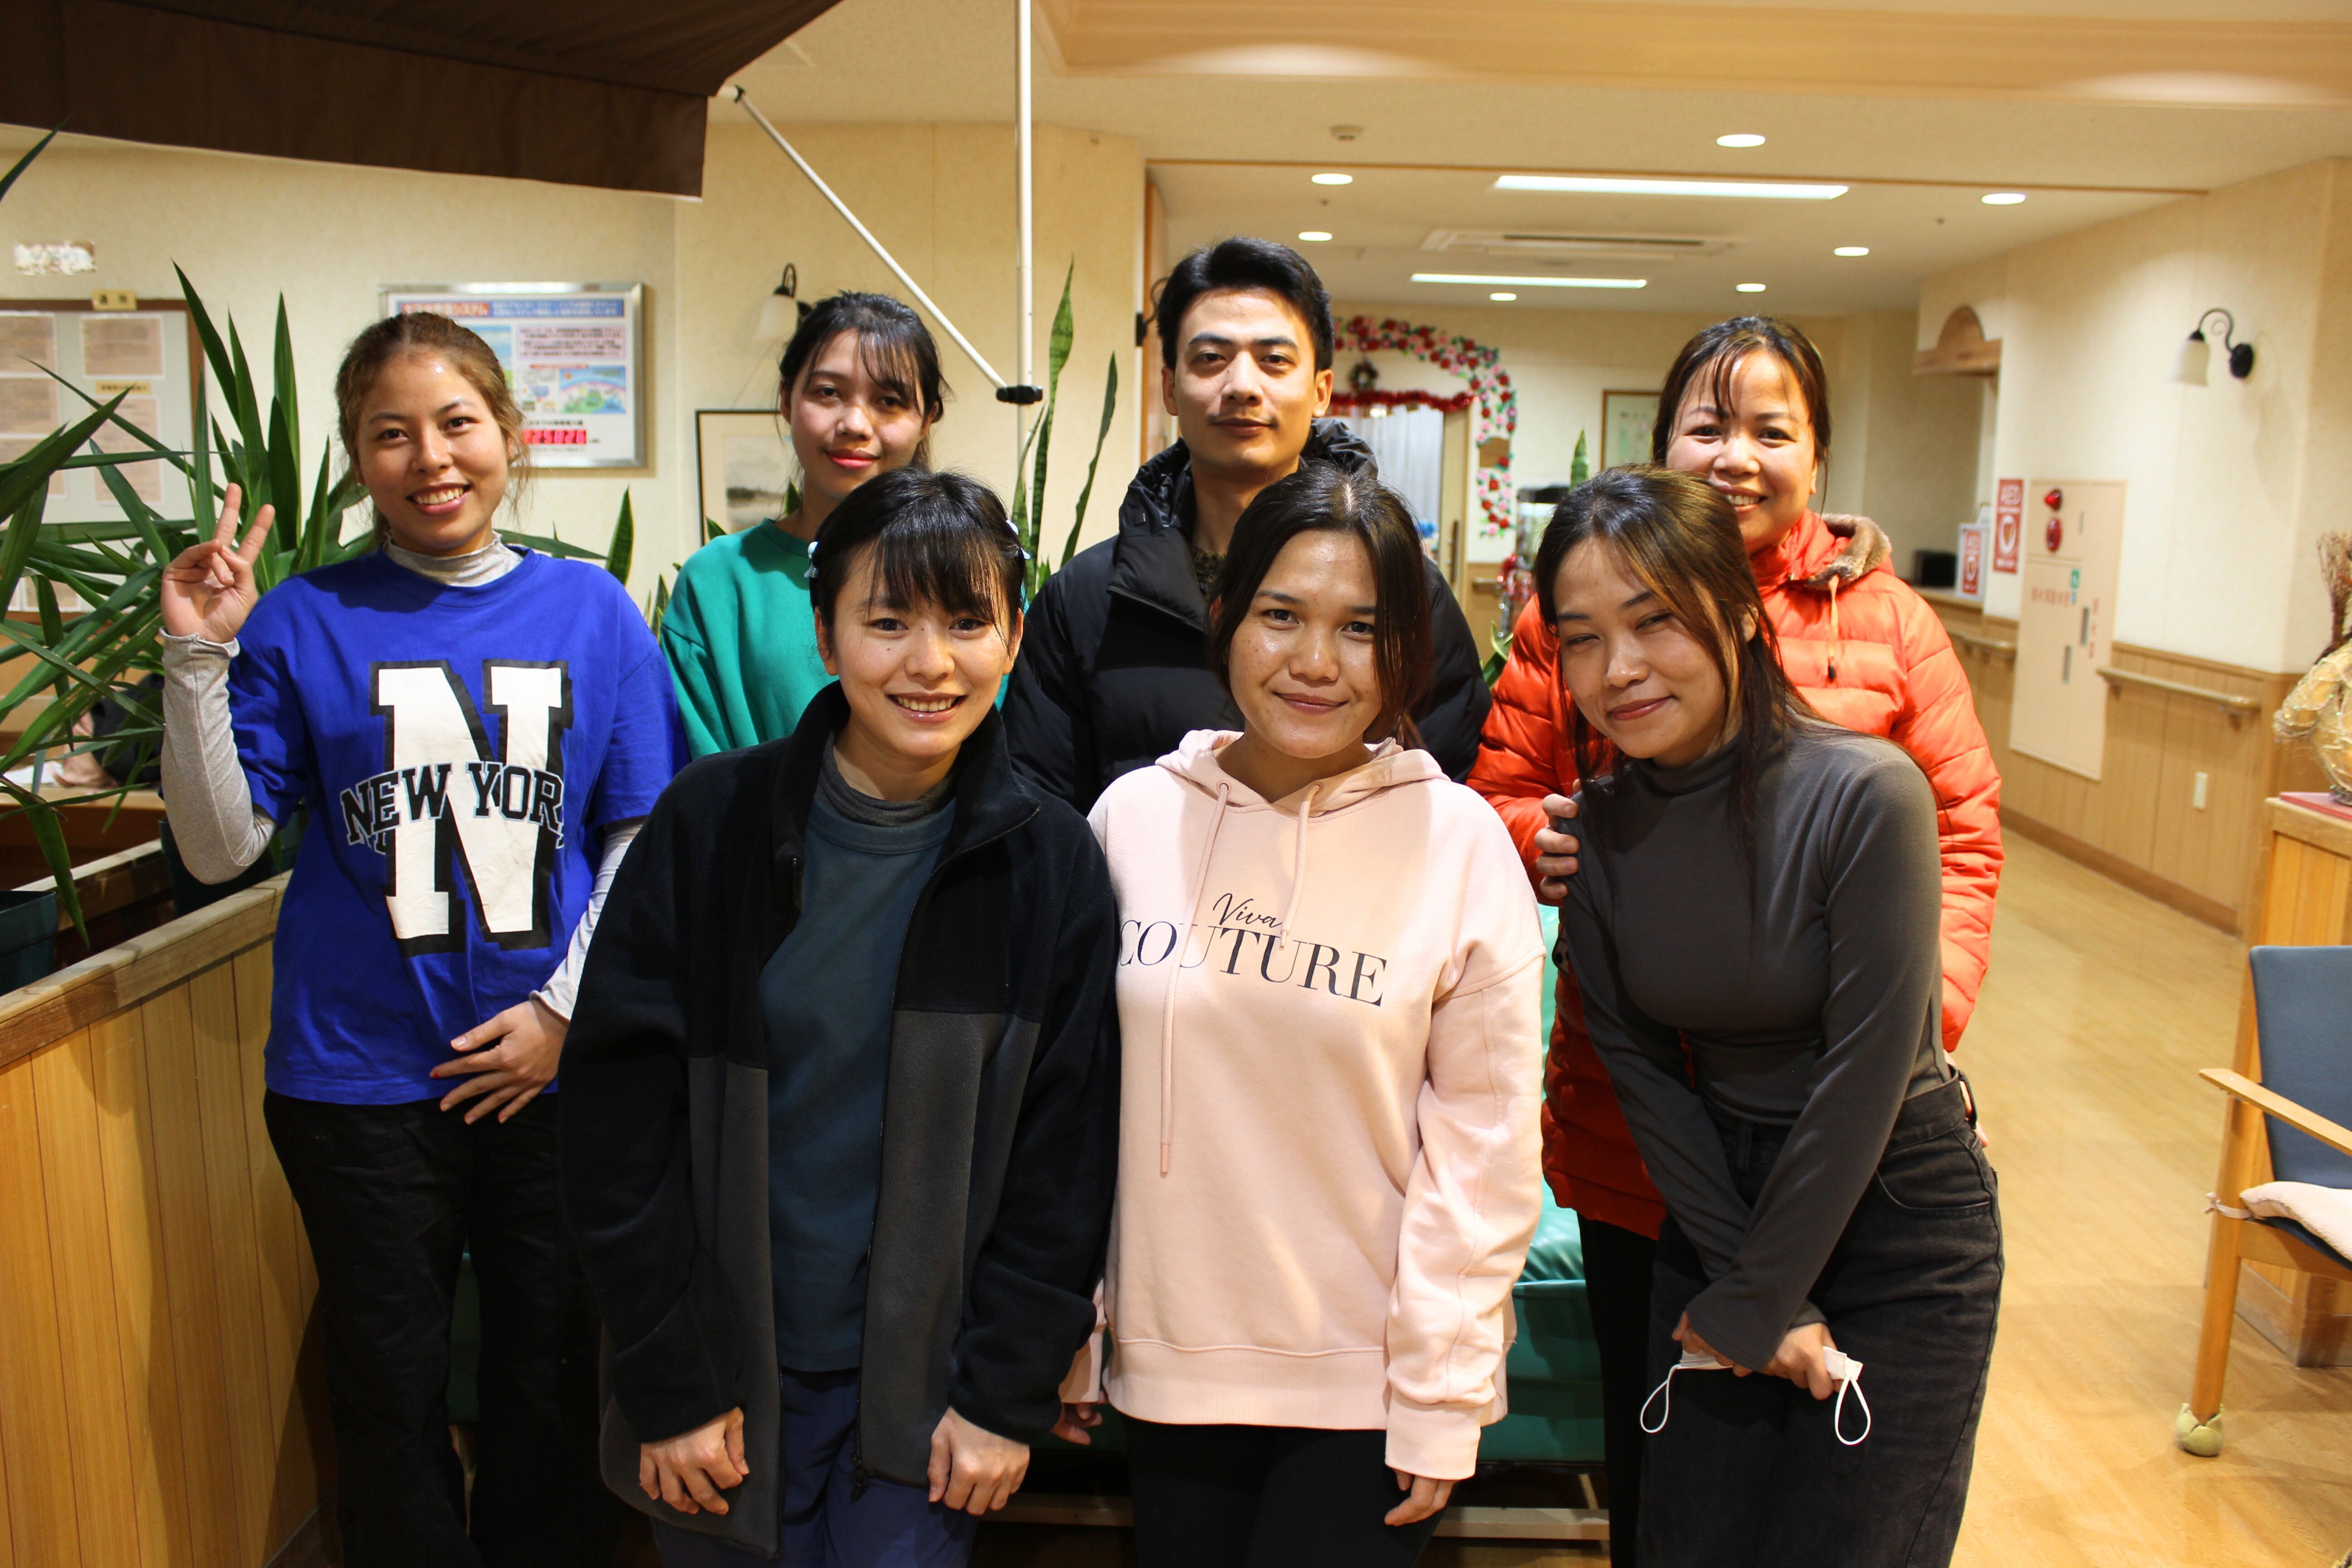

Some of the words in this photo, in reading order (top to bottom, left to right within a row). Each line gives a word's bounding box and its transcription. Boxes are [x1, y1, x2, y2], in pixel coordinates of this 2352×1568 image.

[2001, 484, 2021, 505] AED
[340, 762, 453, 845] NEW
[466, 761, 564, 849] YOR
[1212, 893, 1283, 928] Viva
[1119, 920, 1387, 1007] COUTURE
